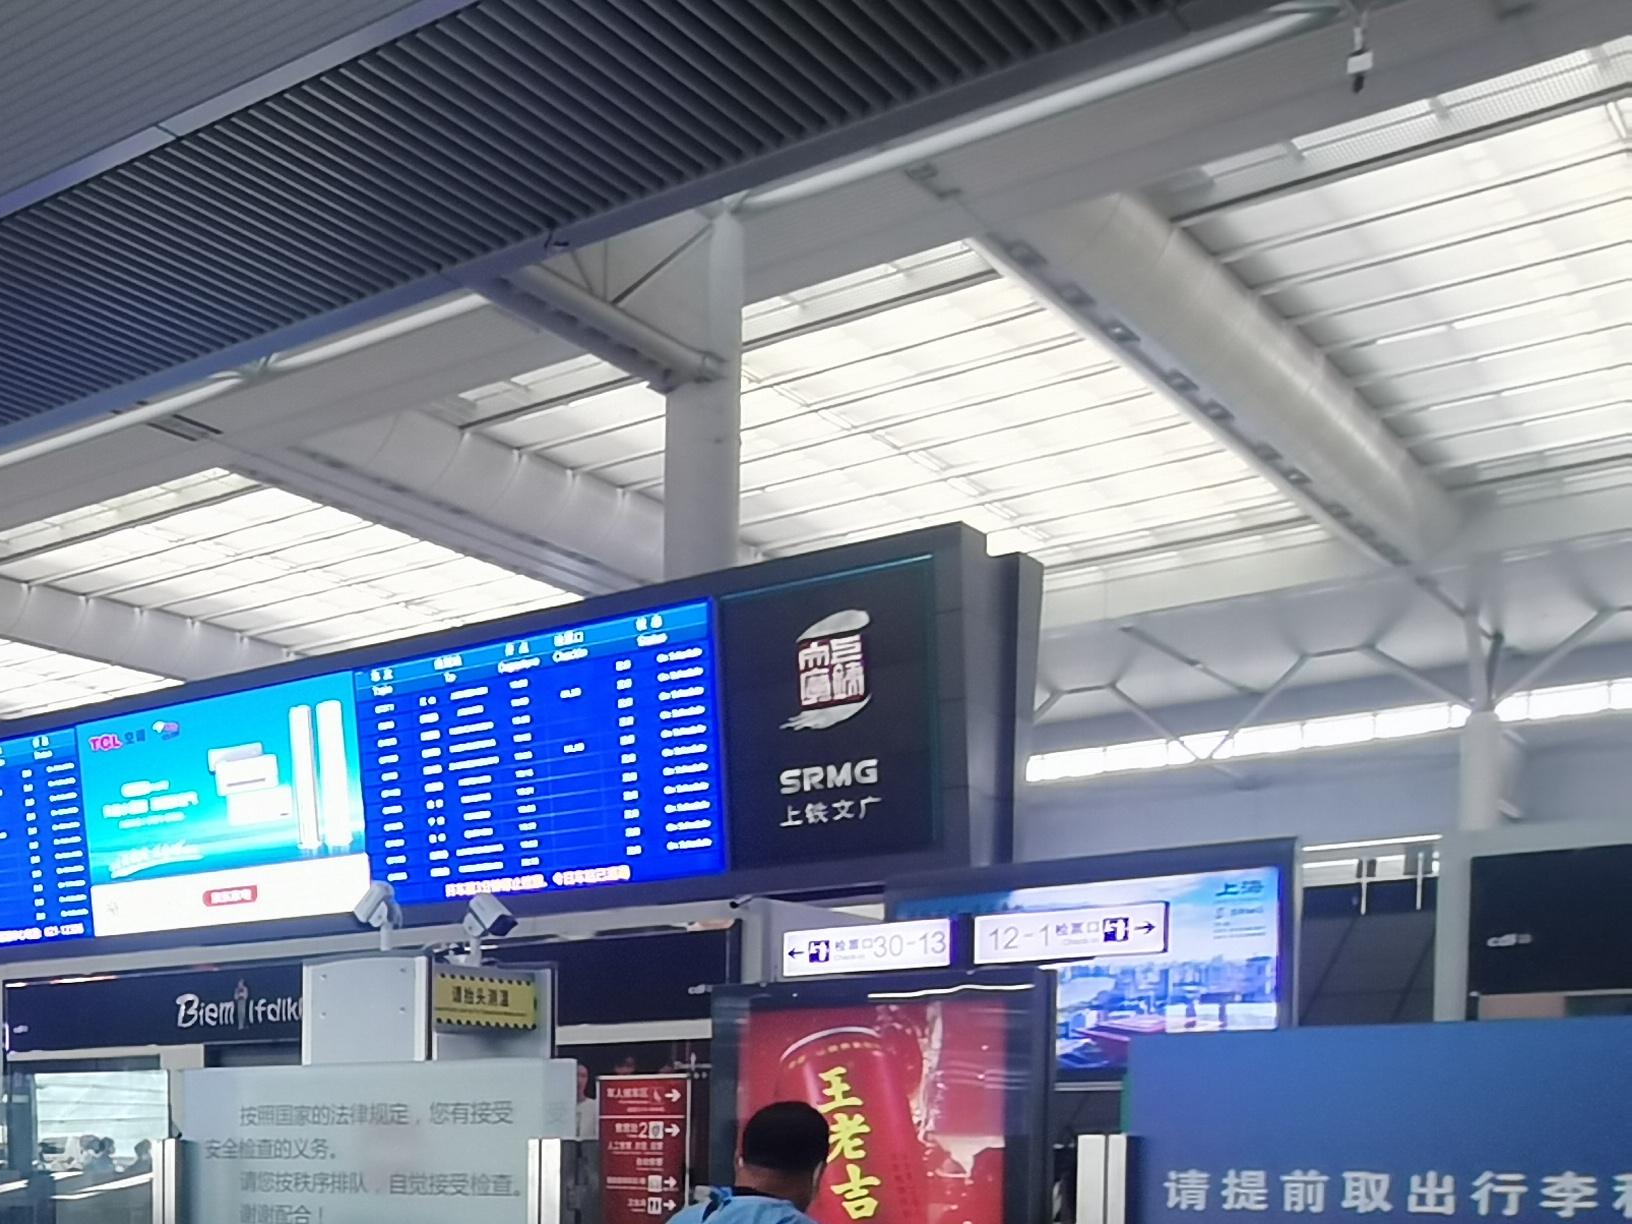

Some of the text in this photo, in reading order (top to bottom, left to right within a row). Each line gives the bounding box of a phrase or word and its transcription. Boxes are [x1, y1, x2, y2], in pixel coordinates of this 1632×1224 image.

[89, 733, 124, 752] TCL
[779, 758, 880, 795] SRMG
[779, 796, 883, 828] 上铁文广
[873, 931, 947, 958] 30-13
[988, 924, 1050, 951] 12-1
[818, 1066, 881, 1219] 王老吉
